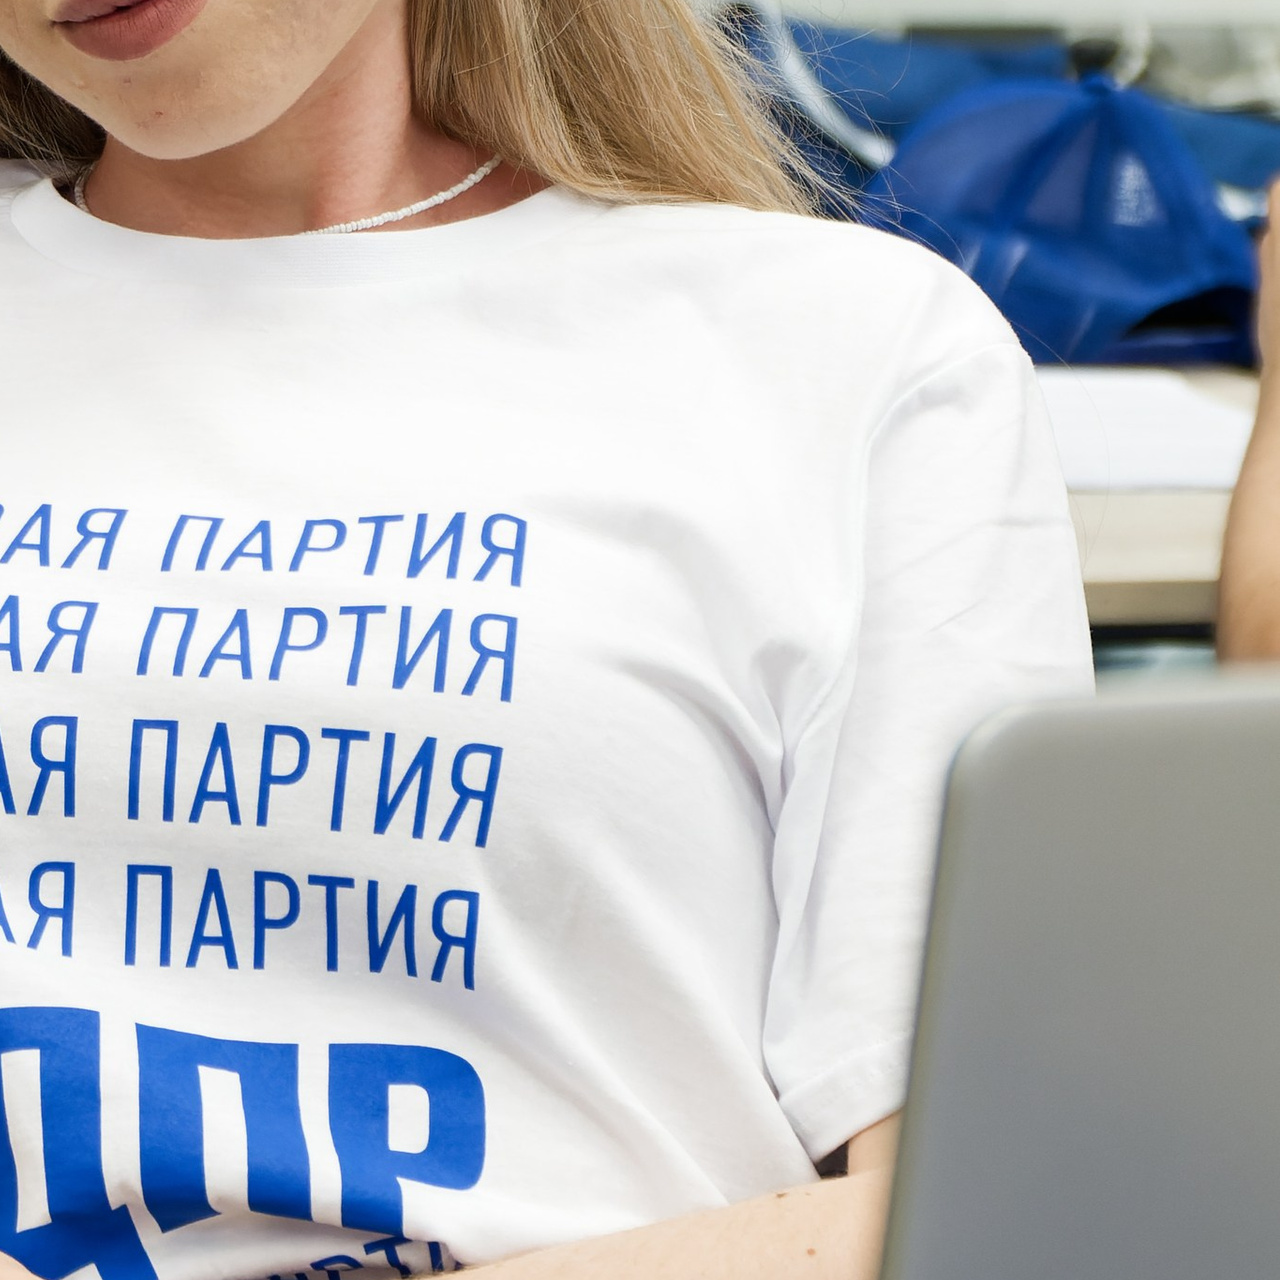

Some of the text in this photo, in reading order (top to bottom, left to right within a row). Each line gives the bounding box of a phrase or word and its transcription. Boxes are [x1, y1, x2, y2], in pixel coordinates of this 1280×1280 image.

[161, 511, 528, 588] ПАРТИЯ
[136, 604, 519, 703] ПАРТИЯ
[127, 718, 504, 848] ПАРТИЯ
[124, 863, 480, 991] ПАРТИЯ
